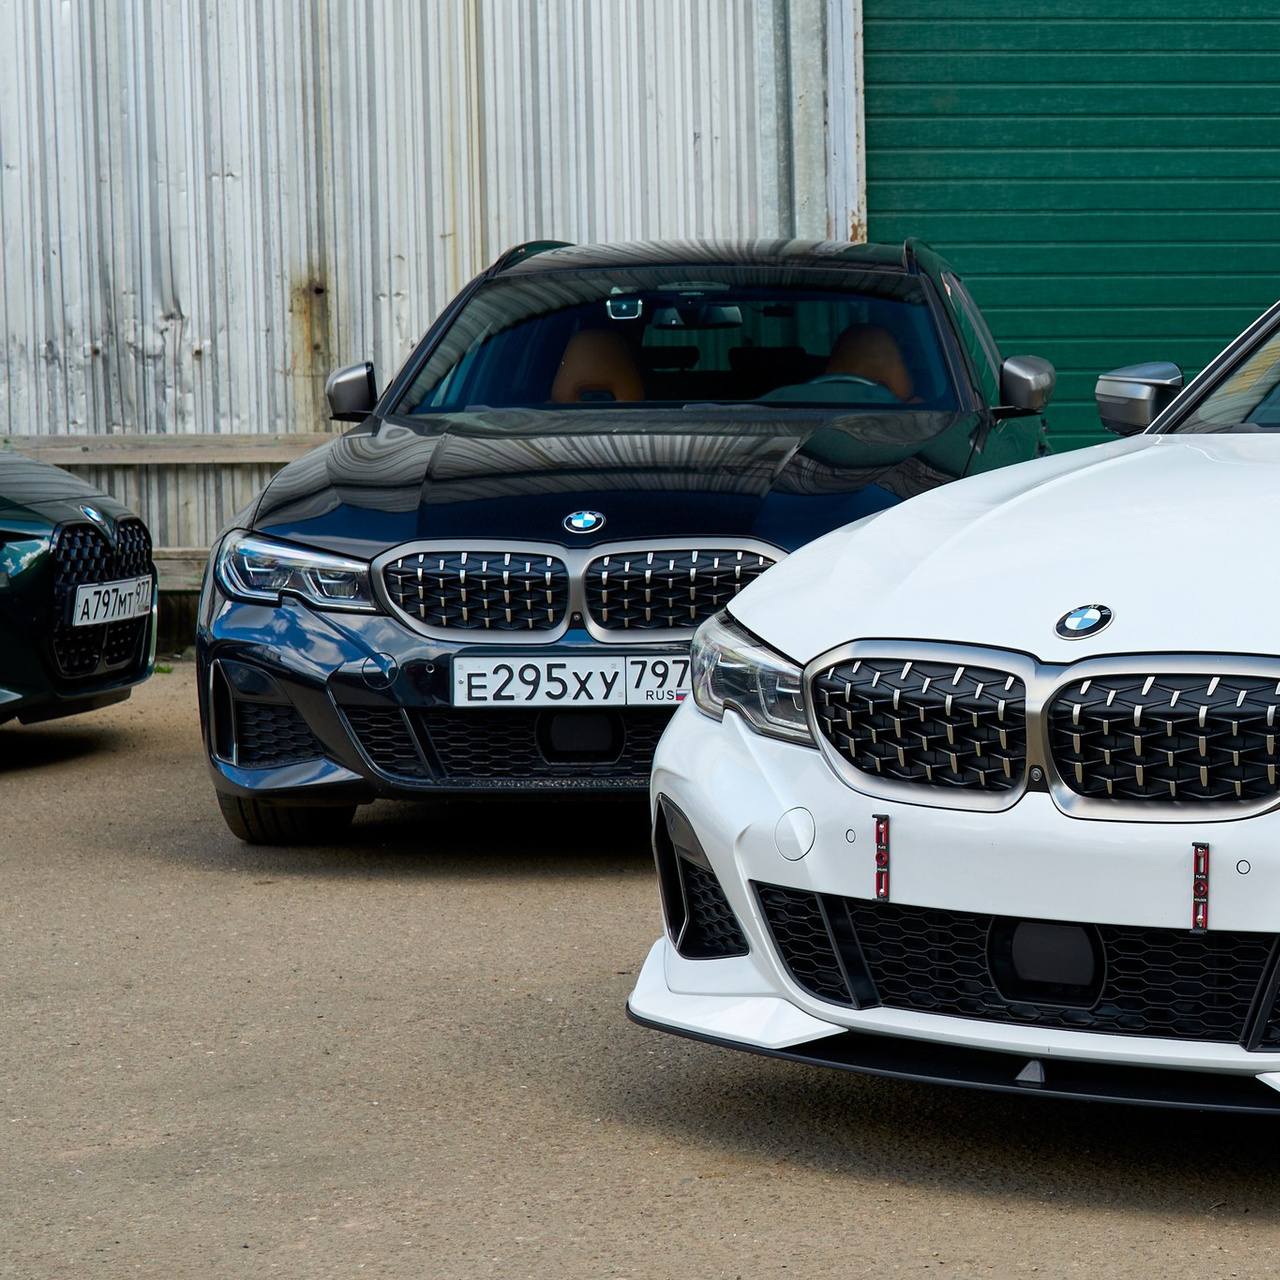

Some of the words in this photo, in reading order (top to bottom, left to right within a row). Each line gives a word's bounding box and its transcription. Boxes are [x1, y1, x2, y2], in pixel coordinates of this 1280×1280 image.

[80, 588, 134, 621] A797MT
[136, 580, 150, 604] 977
[466, 662, 620, 701] E295XY
[630, 659, 690, 688] 797
[646, 690, 674, 701] RUS
